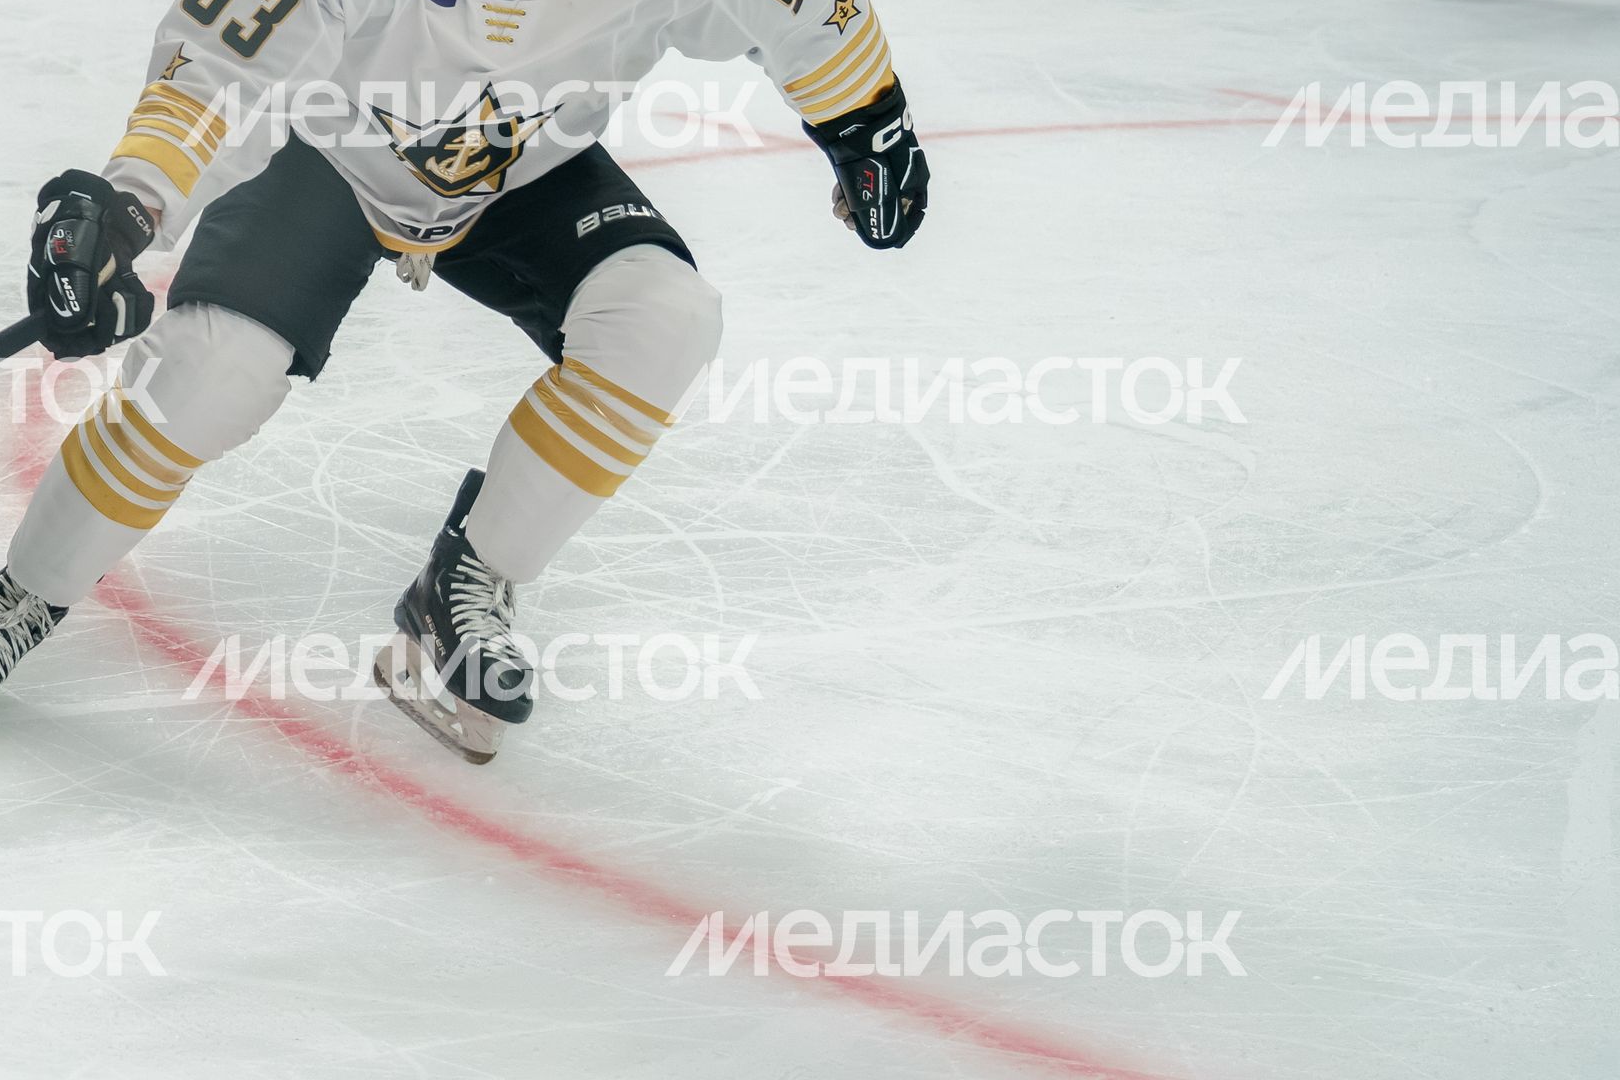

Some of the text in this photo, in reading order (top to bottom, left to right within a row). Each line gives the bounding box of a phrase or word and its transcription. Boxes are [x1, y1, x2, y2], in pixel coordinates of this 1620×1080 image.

[127, 205, 153, 237] CCM
[870, 207, 879, 240] CCM
[60, 277, 81, 312] CCM
